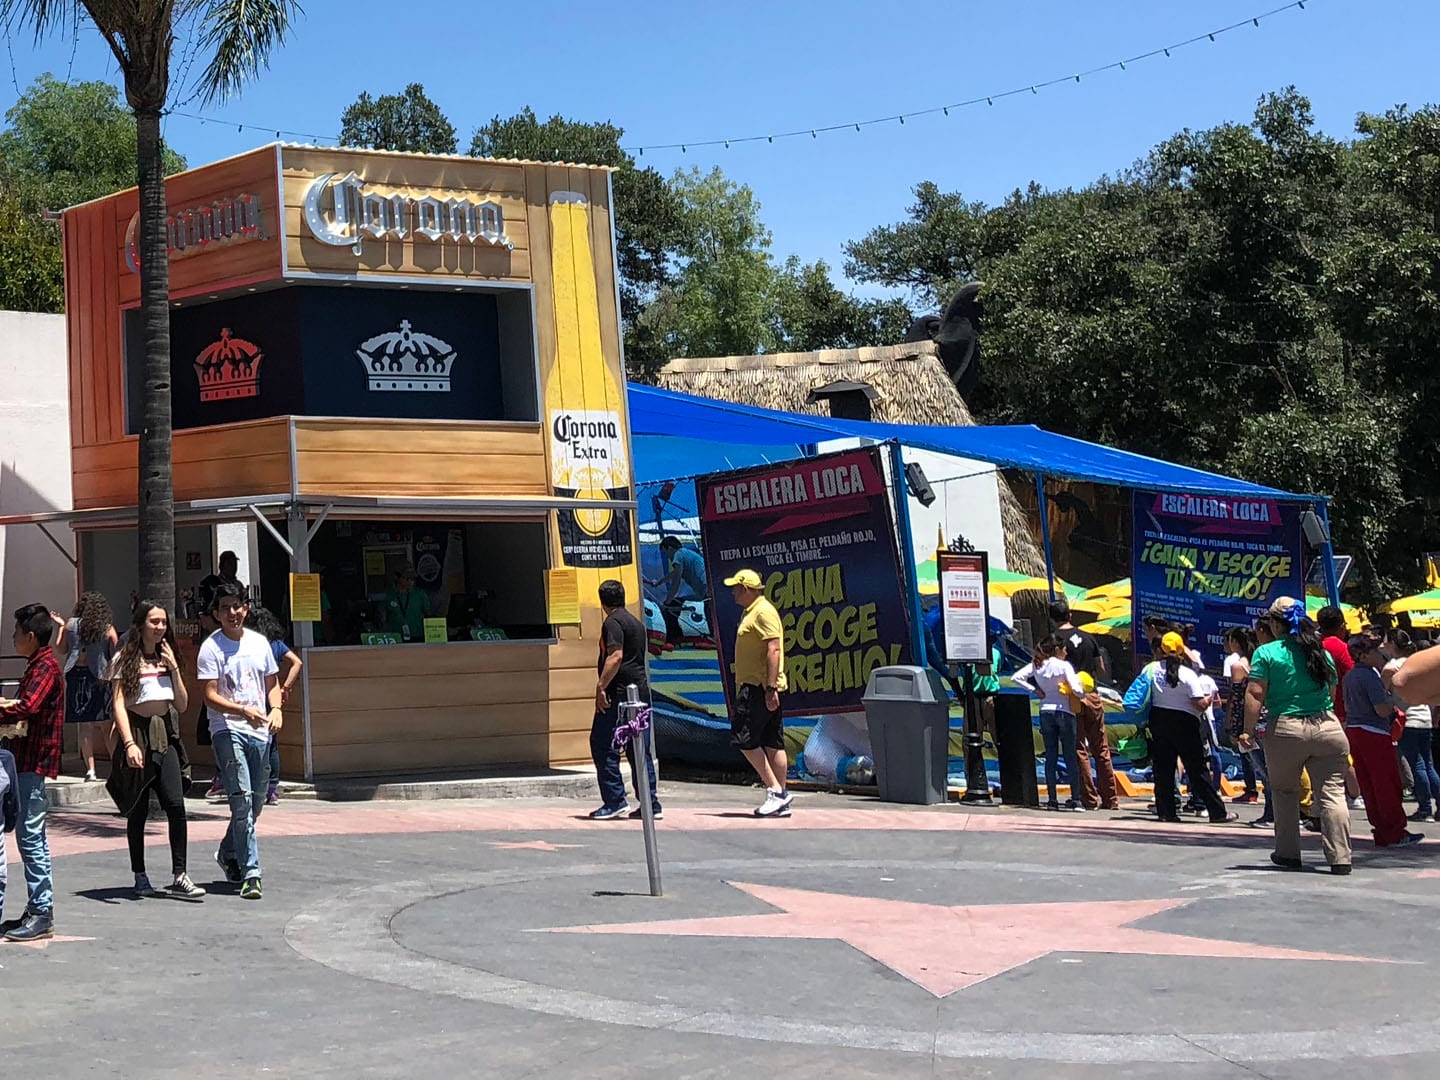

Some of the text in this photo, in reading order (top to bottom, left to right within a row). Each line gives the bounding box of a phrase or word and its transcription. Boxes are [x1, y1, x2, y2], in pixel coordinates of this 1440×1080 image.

[305, 171, 509, 257] Corona
[553, 414, 618, 446] Corona
[572, 441, 608, 460] Extra
[714, 464, 865, 514] ESCALERA LOCA
[1162, 493, 1270, 522] ESCALERA LOCA
[720, 548, 742, 561] TREPA
[743, 547, 752, 559] LA
[790, 538, 808, 553] PISA
[809, 537, 818, 549] EL
[819, 531, 852, 548] PELDAÑO
[766, 553, 784, 566] TOCA
[785, 552, 794, 564] EL
[1140, 541, 1292, 578] ¡GANA Y ESCOGE
[760, 563, 844, 609] GANA
[1165, 568, 1272, 601] TU PREMIO!
[175, 623, 199, 637] ntrega
[783, 601, 879, 653] SCOGE
